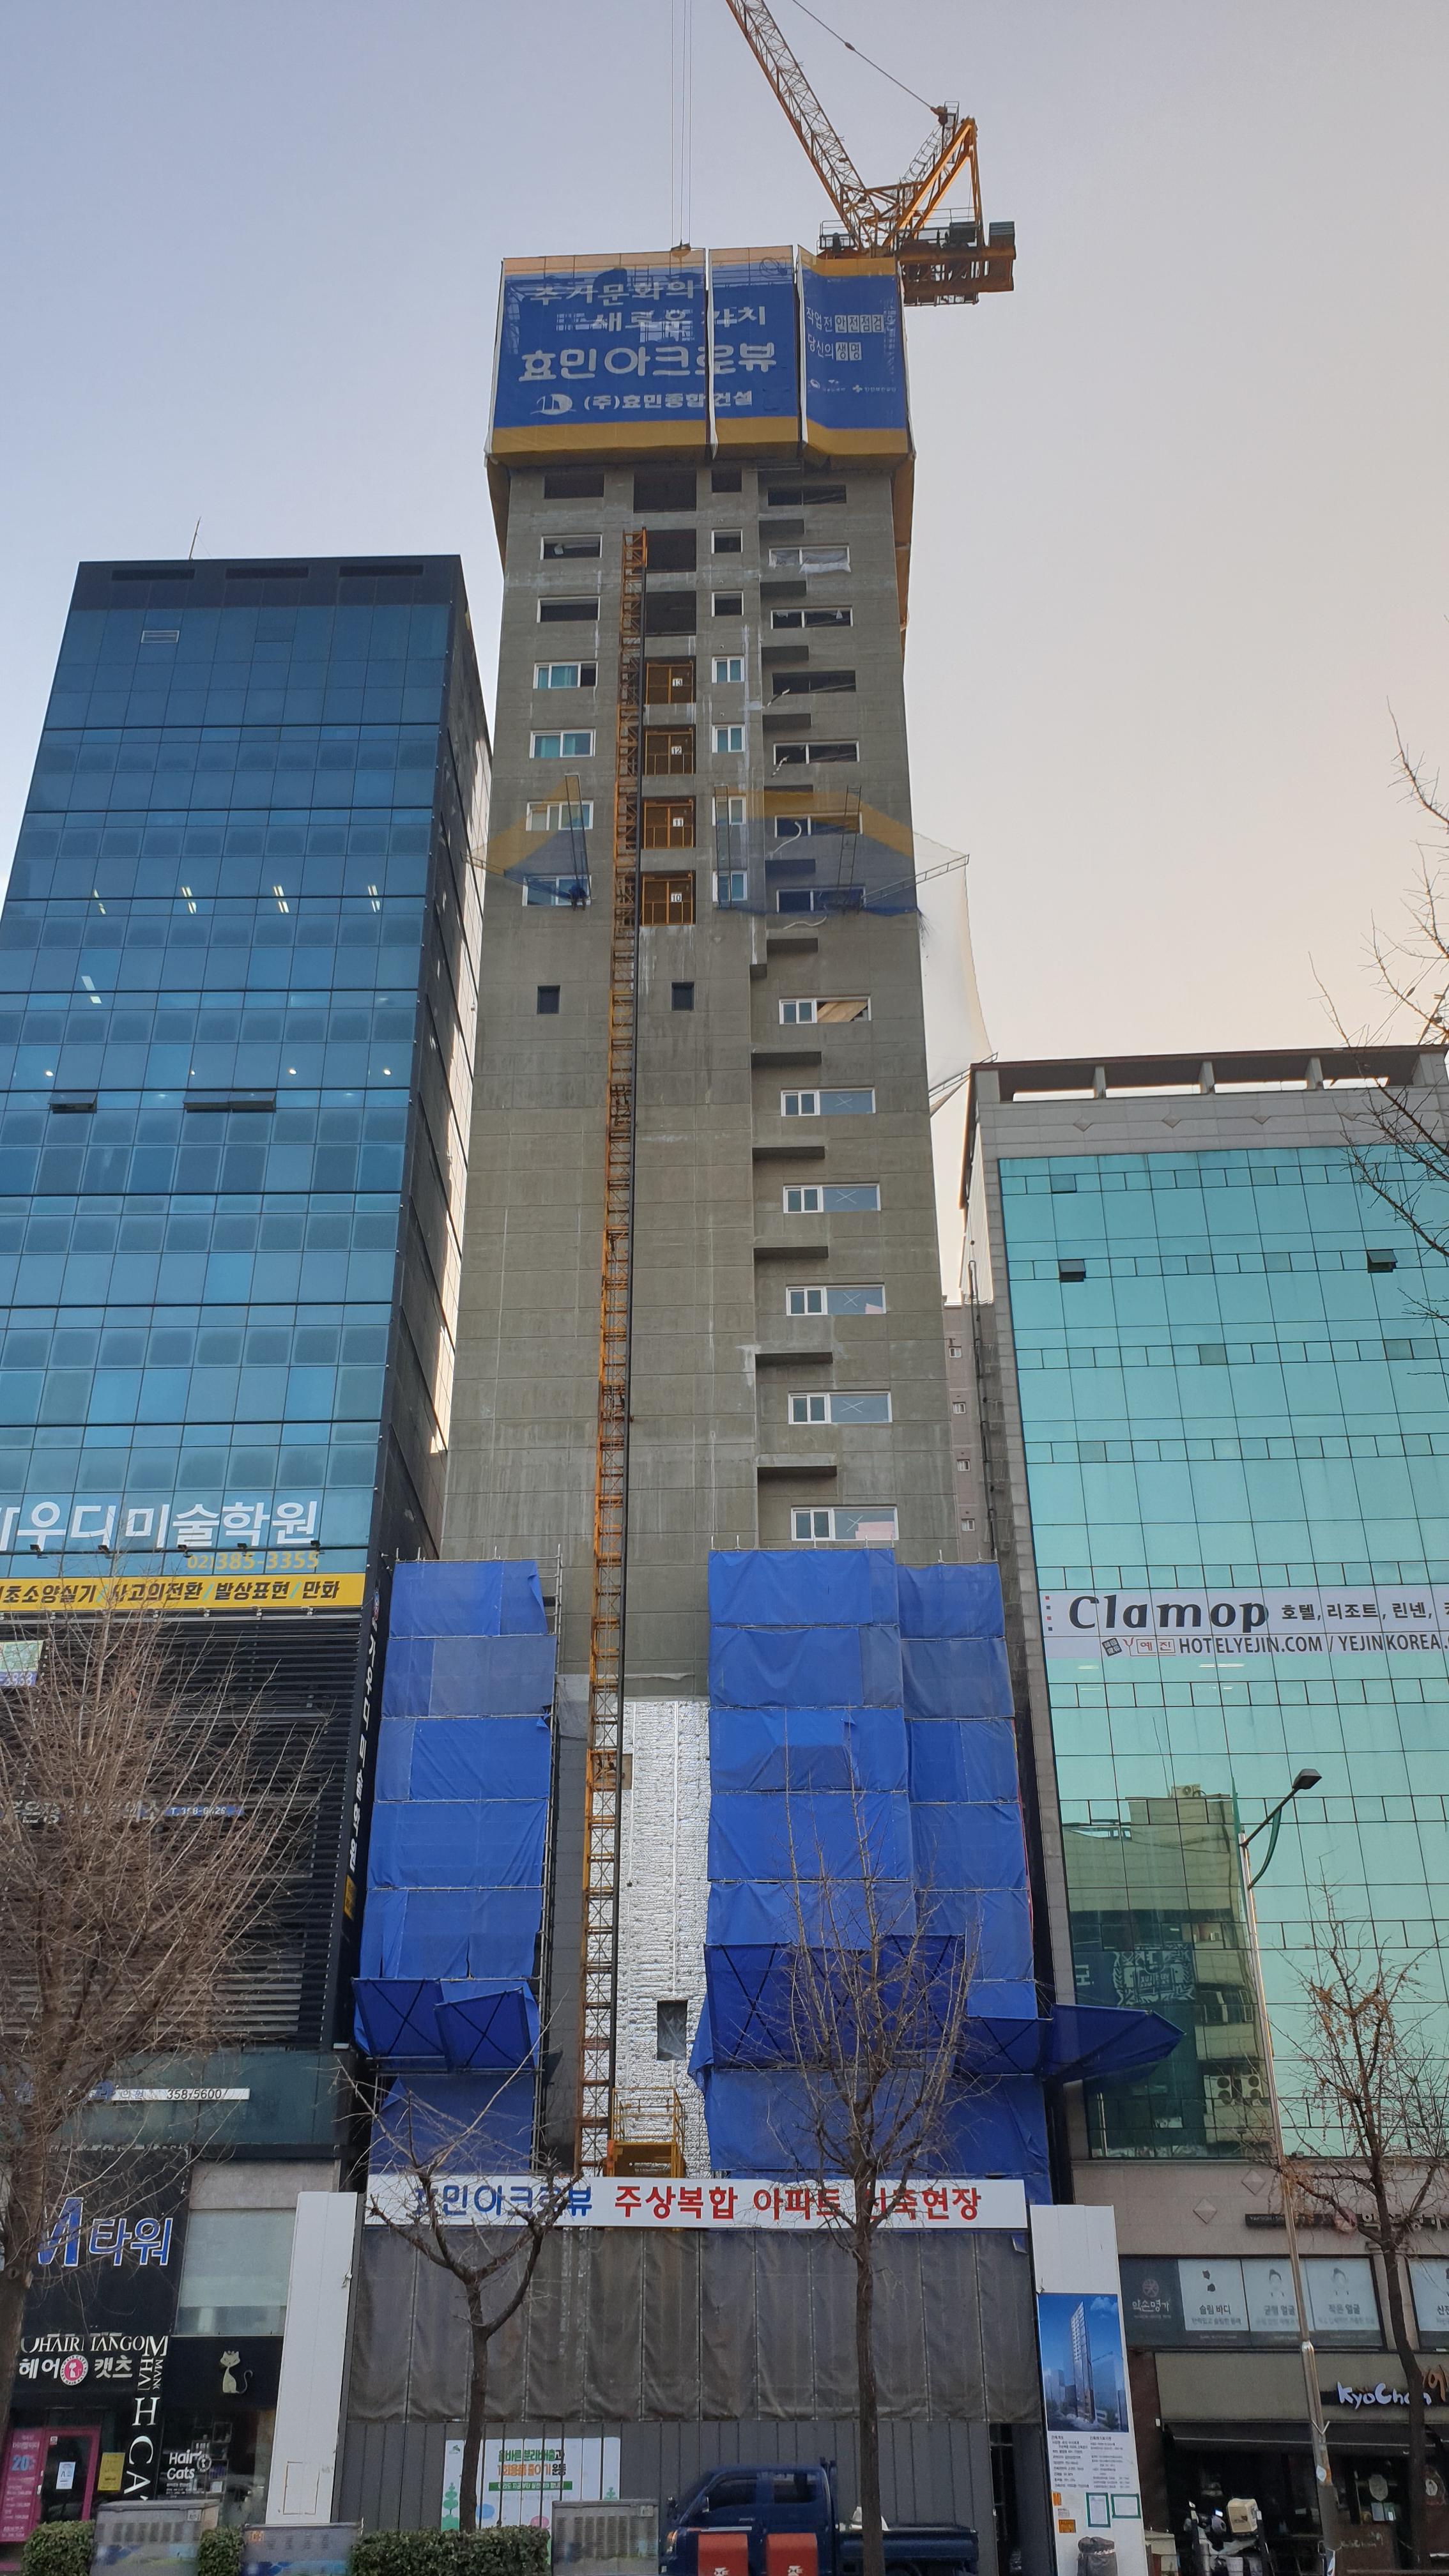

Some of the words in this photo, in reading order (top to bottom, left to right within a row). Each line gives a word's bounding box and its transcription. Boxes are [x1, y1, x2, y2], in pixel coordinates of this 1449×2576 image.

[808, 334, 834, 360] 당신의
[835, 342, 862, 360] 생명
[518, 342, 777, 382] 효민아크로뷰
[0, 1584, 97, 1604] 초소양실기
[215, 1581, 289, 1600] 발상표현
[302, 1581, 340, 1599] 만화
[1069, 1594, 1269, 1634] Clamop
[1282, 1604, 1321, 1621] 호텔,
[1327, 1603, 1386, 1620] 리조트,
[1392, 1602, 1432, 1620] 린넨,
[1179, 1636, 1323, 1653] HOTELYEJIN.COM
[1338, 1634, 1449, 1652] YEJINKOREA.
[615, 2186, 738, 2220] 주상복합
[753, 2187, 842, 2220] 아파트
[1216, 2304, 1231, 2315] 바디
[19, 2358, 60, 2379] 헤어
[94, 2354, 133, 2379] 캣츠
[169, 2449, 203, 2465] Hair
[166, 2467, 195, 2480] Cats
